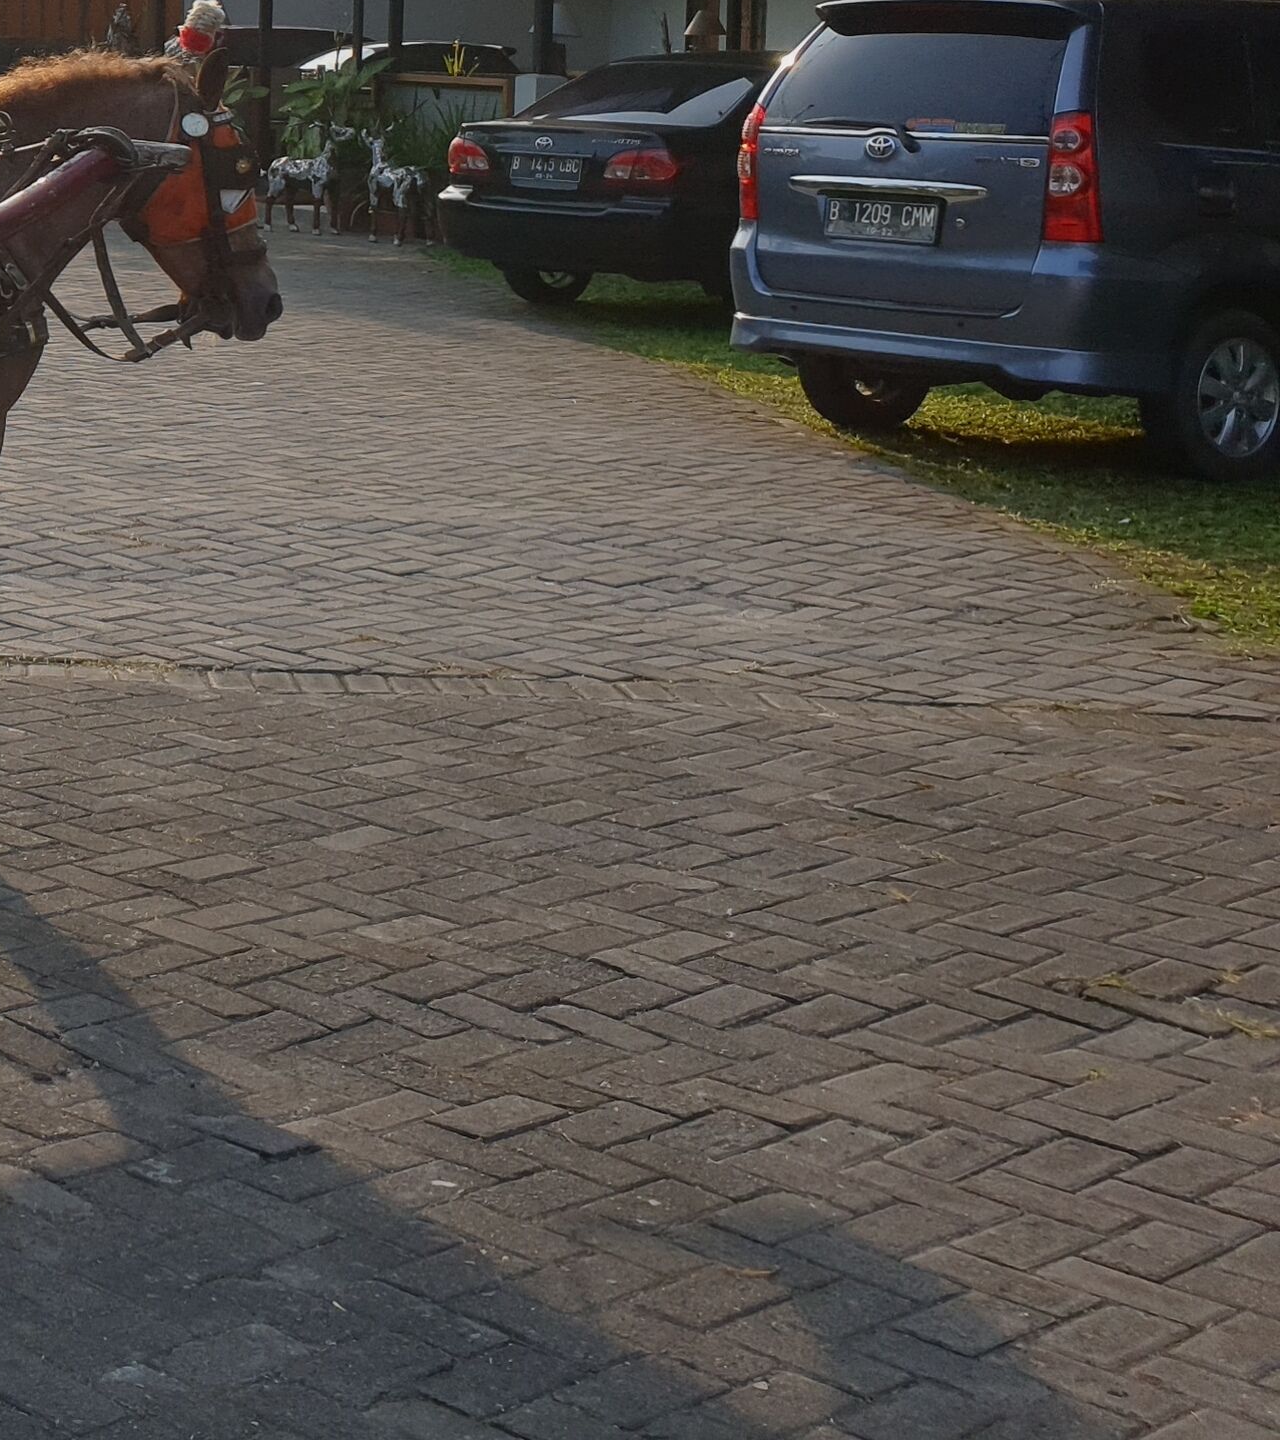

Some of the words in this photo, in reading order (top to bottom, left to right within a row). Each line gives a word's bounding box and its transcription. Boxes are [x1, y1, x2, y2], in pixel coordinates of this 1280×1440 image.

[512, 155, 521, 170] B
[829, 200, 840, 221] B
[855, 202, 892, 225] 1209
[901, 205, 935, 227] CMM
